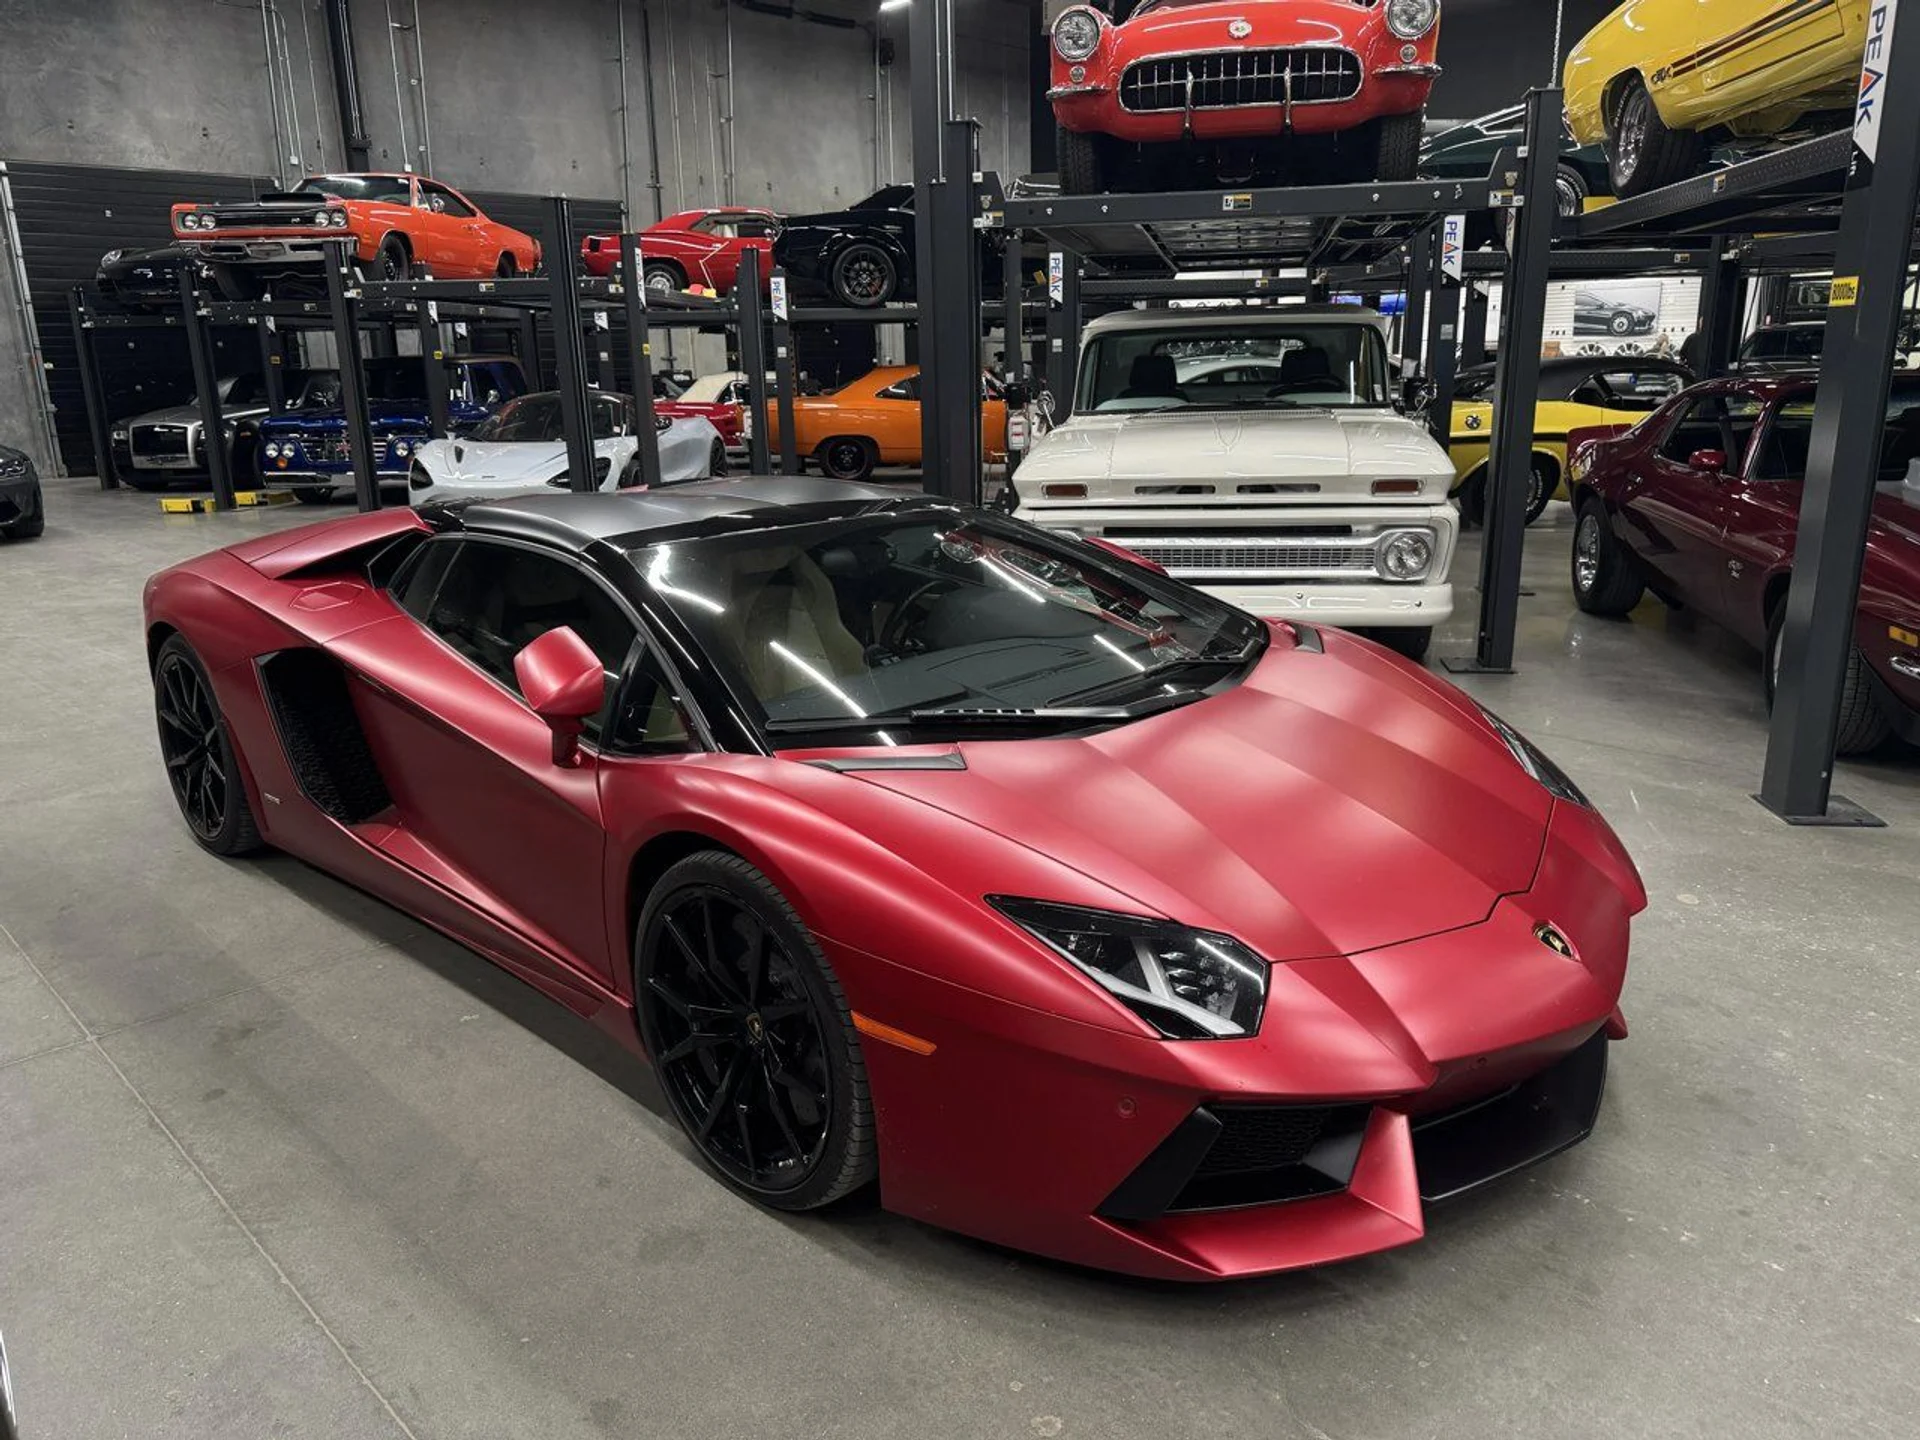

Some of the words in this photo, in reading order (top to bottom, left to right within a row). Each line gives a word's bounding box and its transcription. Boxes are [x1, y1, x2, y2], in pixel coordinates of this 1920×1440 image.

[1856, 5, 1888, 128] PEAK
[1443, 221, 1460, 266] PEAK
[1051, 257, 1063, 293] PEAK
[772, 281, 784, 310] PEAK
